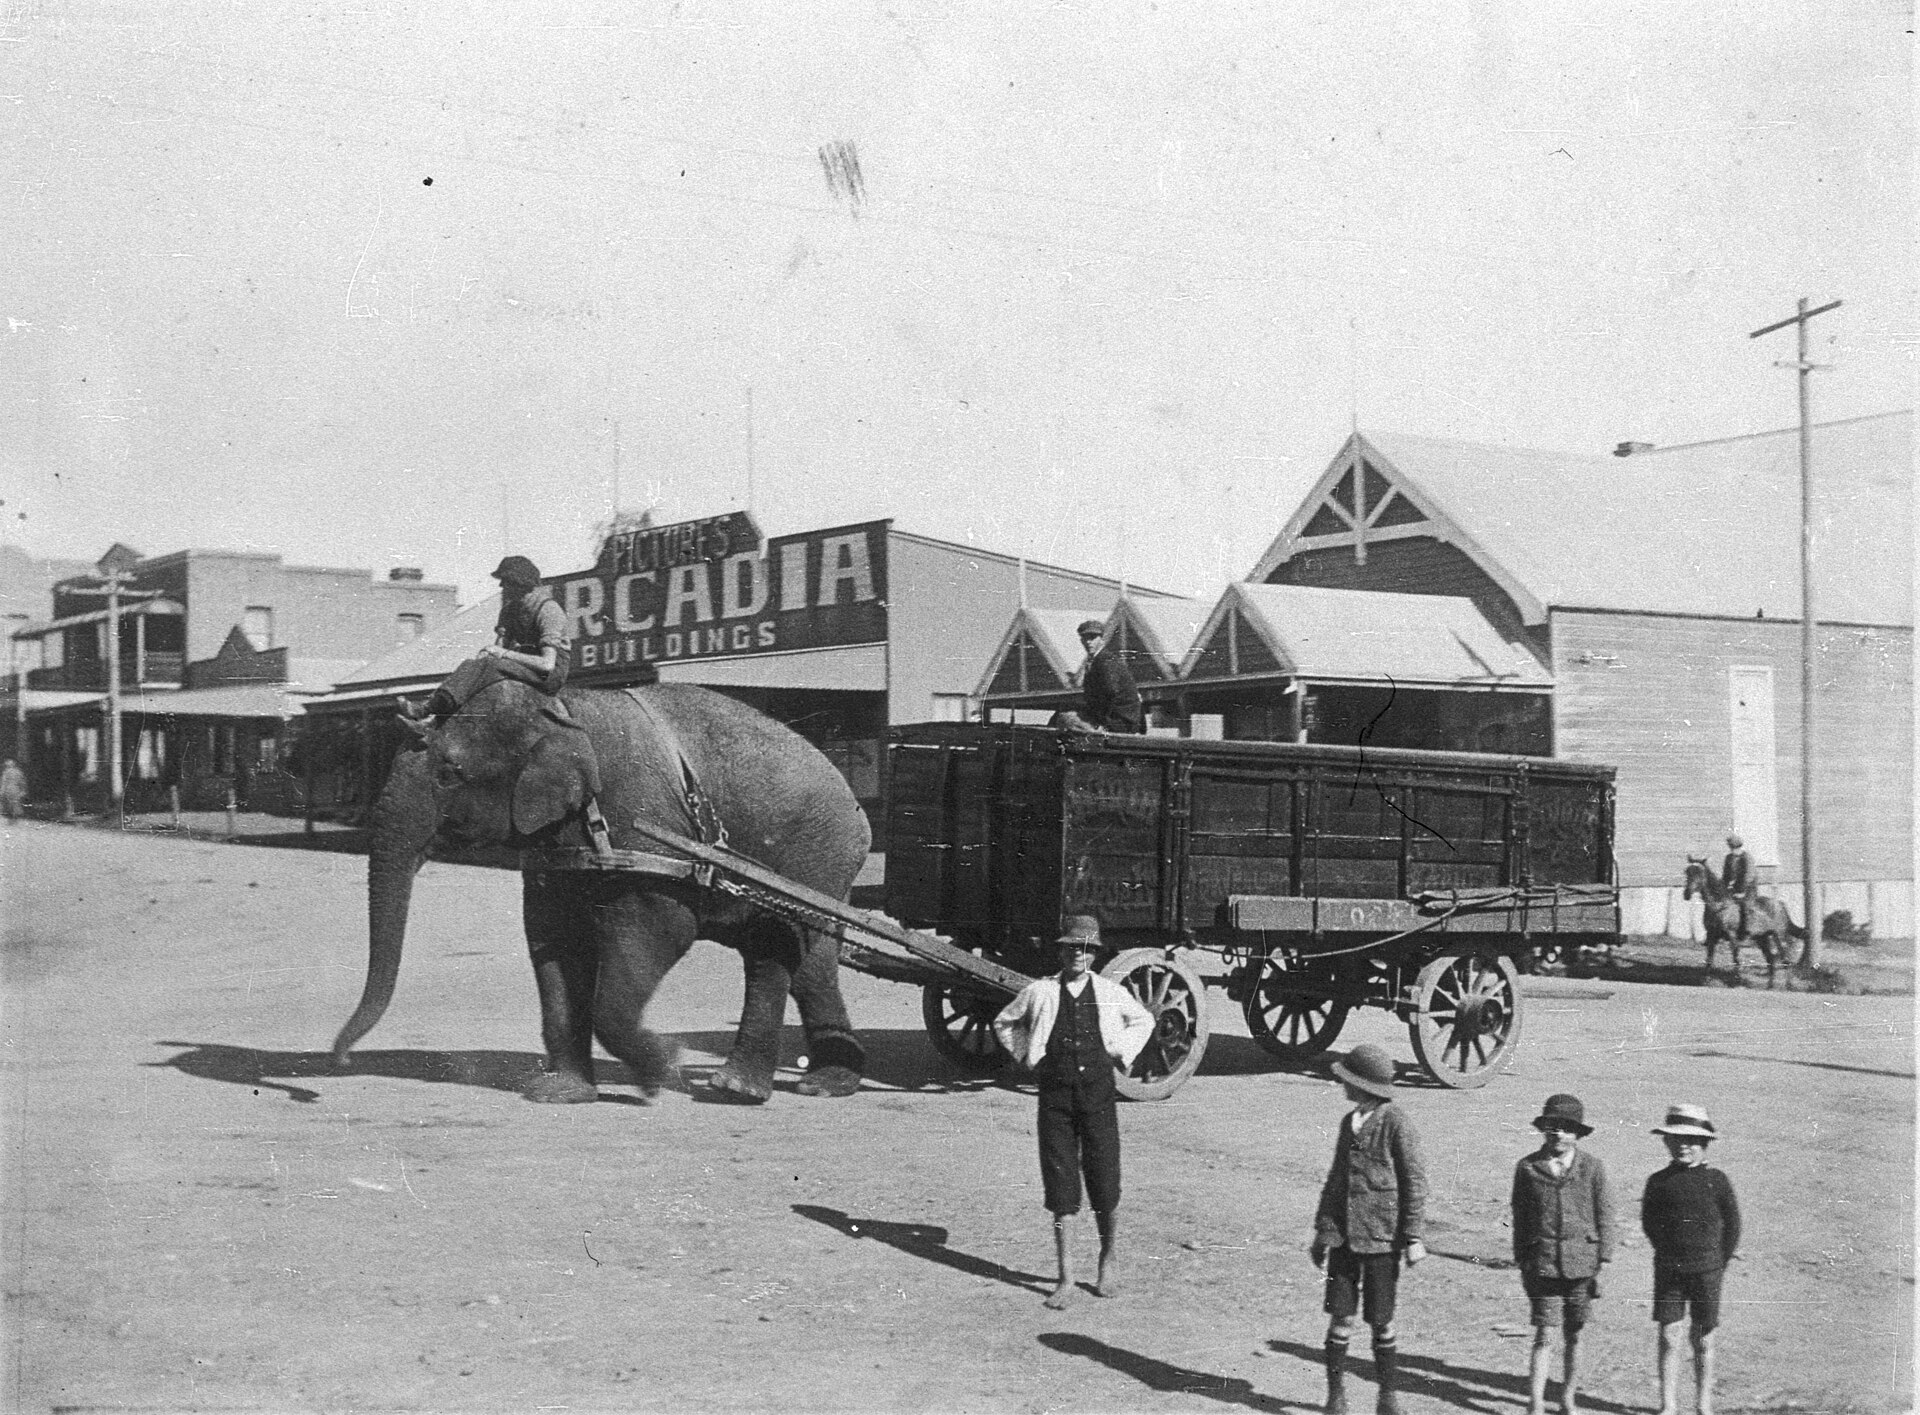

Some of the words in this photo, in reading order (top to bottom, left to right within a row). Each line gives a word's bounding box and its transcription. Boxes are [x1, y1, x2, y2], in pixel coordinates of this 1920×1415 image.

[612, 514, 731, 575] PICTURES
[533, 531, 877, 642] RCADIA
[581, 620, 776, 667] BUILDINGS
